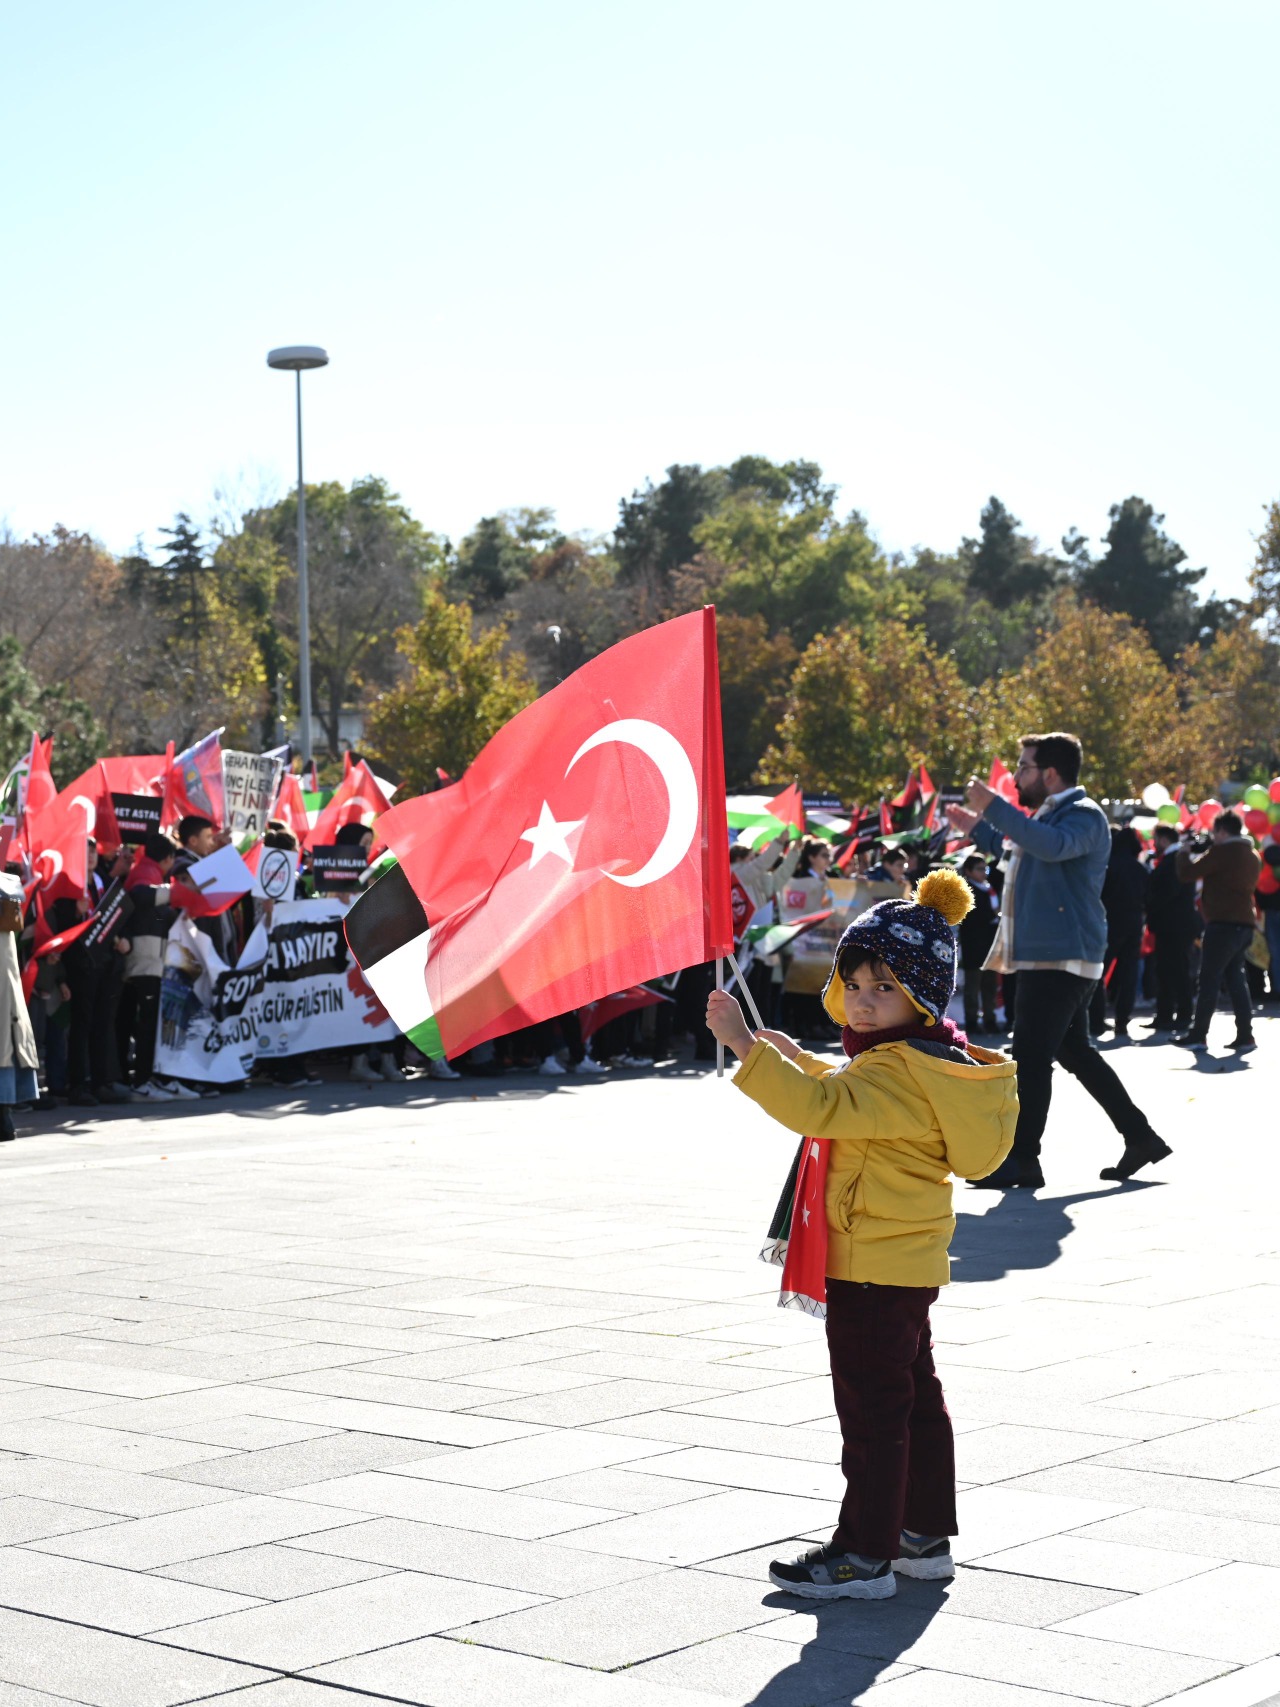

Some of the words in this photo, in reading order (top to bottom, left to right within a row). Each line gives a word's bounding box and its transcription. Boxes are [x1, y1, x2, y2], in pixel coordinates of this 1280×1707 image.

[132, 809, 160, 820] ASTAL
[281, 931, 338, 969] HAYIR
[295, 982, 344, 1019] FİLİSTİN
